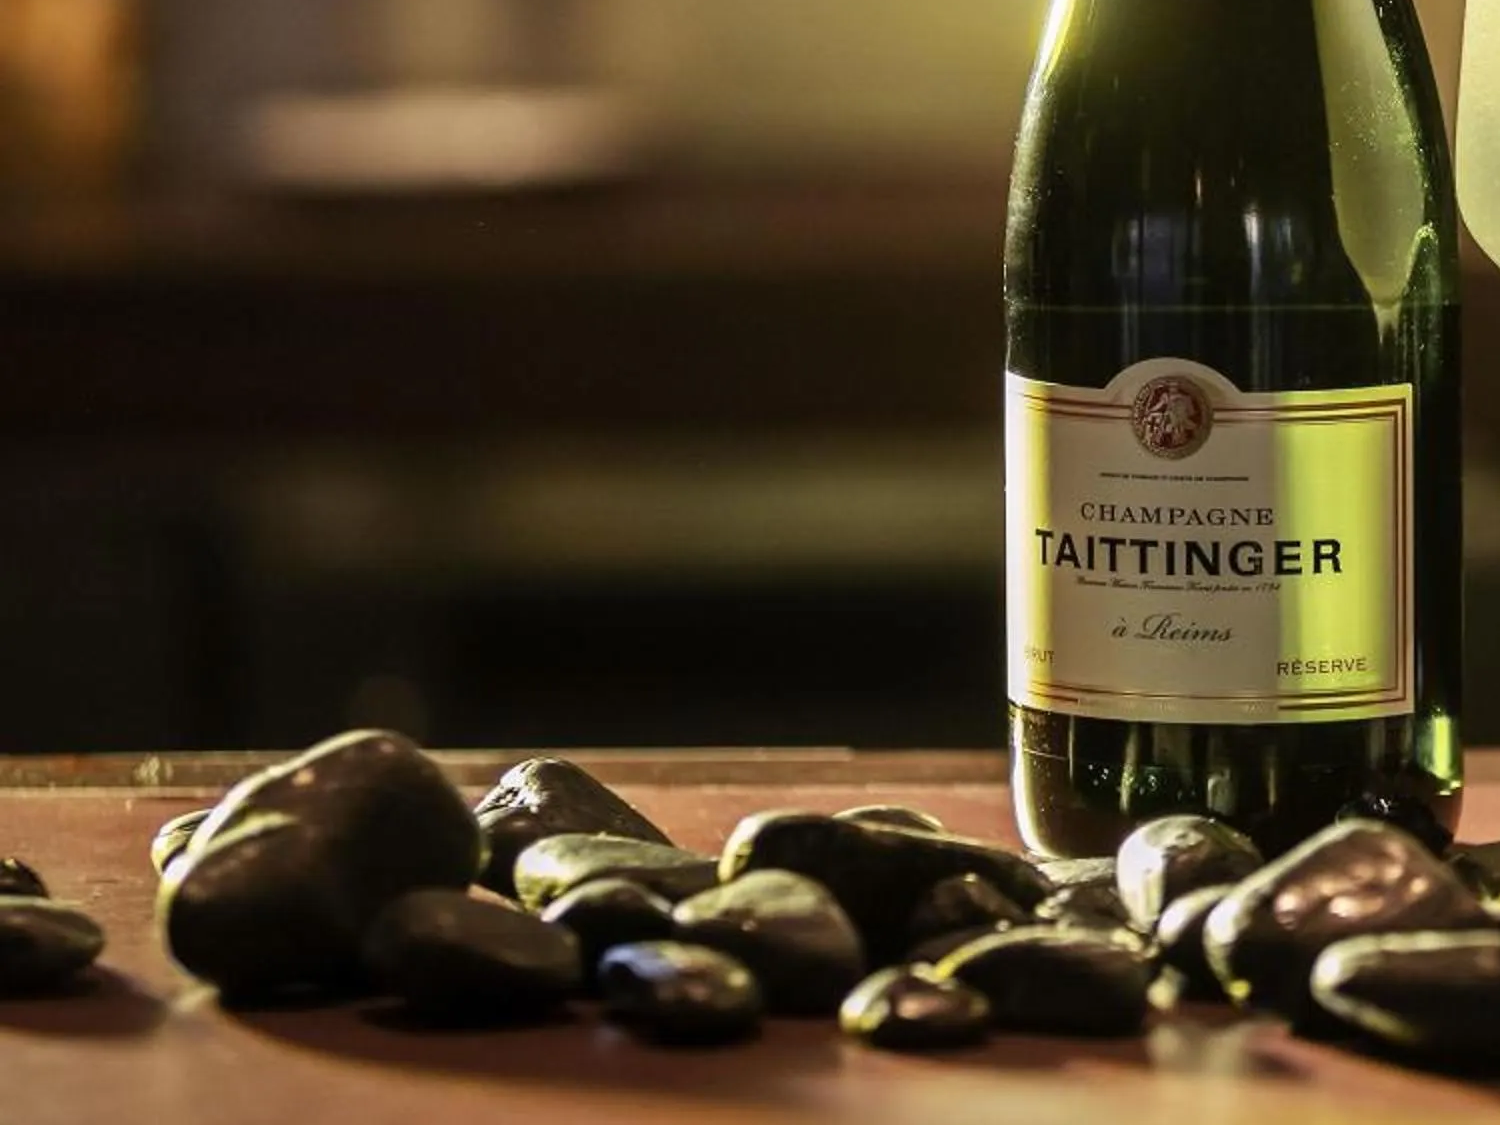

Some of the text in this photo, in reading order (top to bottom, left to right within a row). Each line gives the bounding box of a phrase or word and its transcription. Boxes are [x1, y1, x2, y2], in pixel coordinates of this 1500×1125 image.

[1080, 502, 1275, 526] CHAMPAGNE
[1035, 528, 1343, 577] TAITTINGER
[1111, 612, 1233, 642] à Reims
[1024, 649, 1055, 665] RUT
